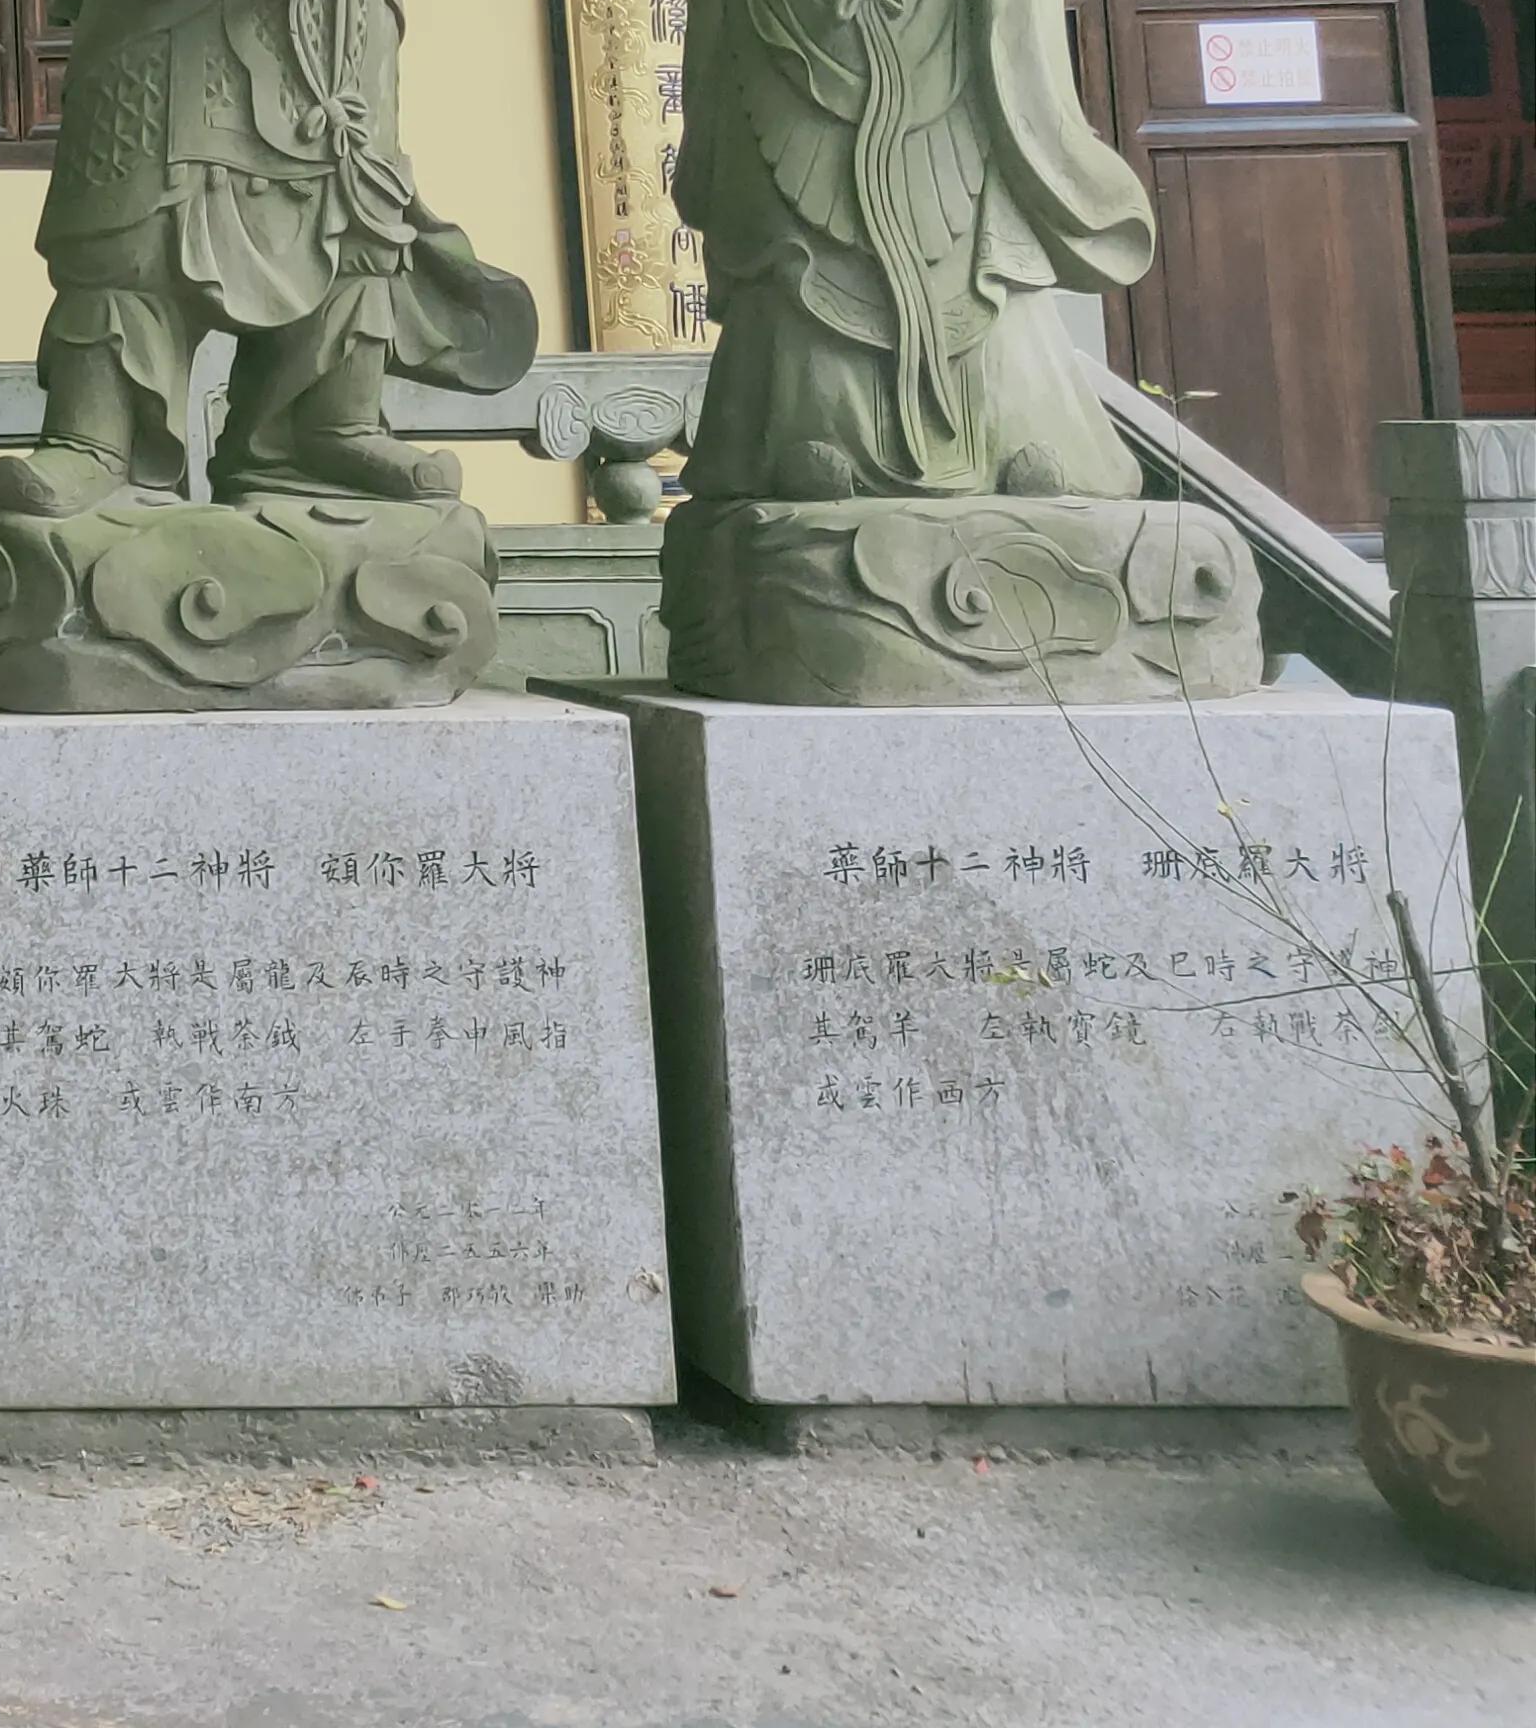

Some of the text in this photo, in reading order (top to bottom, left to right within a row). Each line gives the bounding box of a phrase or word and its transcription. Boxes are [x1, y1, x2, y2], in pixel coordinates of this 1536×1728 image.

[17, 849, 275, 895] 藥師十二神將
[823, 845, 1091, 885] 藥師十二神將
[1, 1085, 71, 1119] 火珠
[816, 1073, 1006, 1112] 或雲作西方
